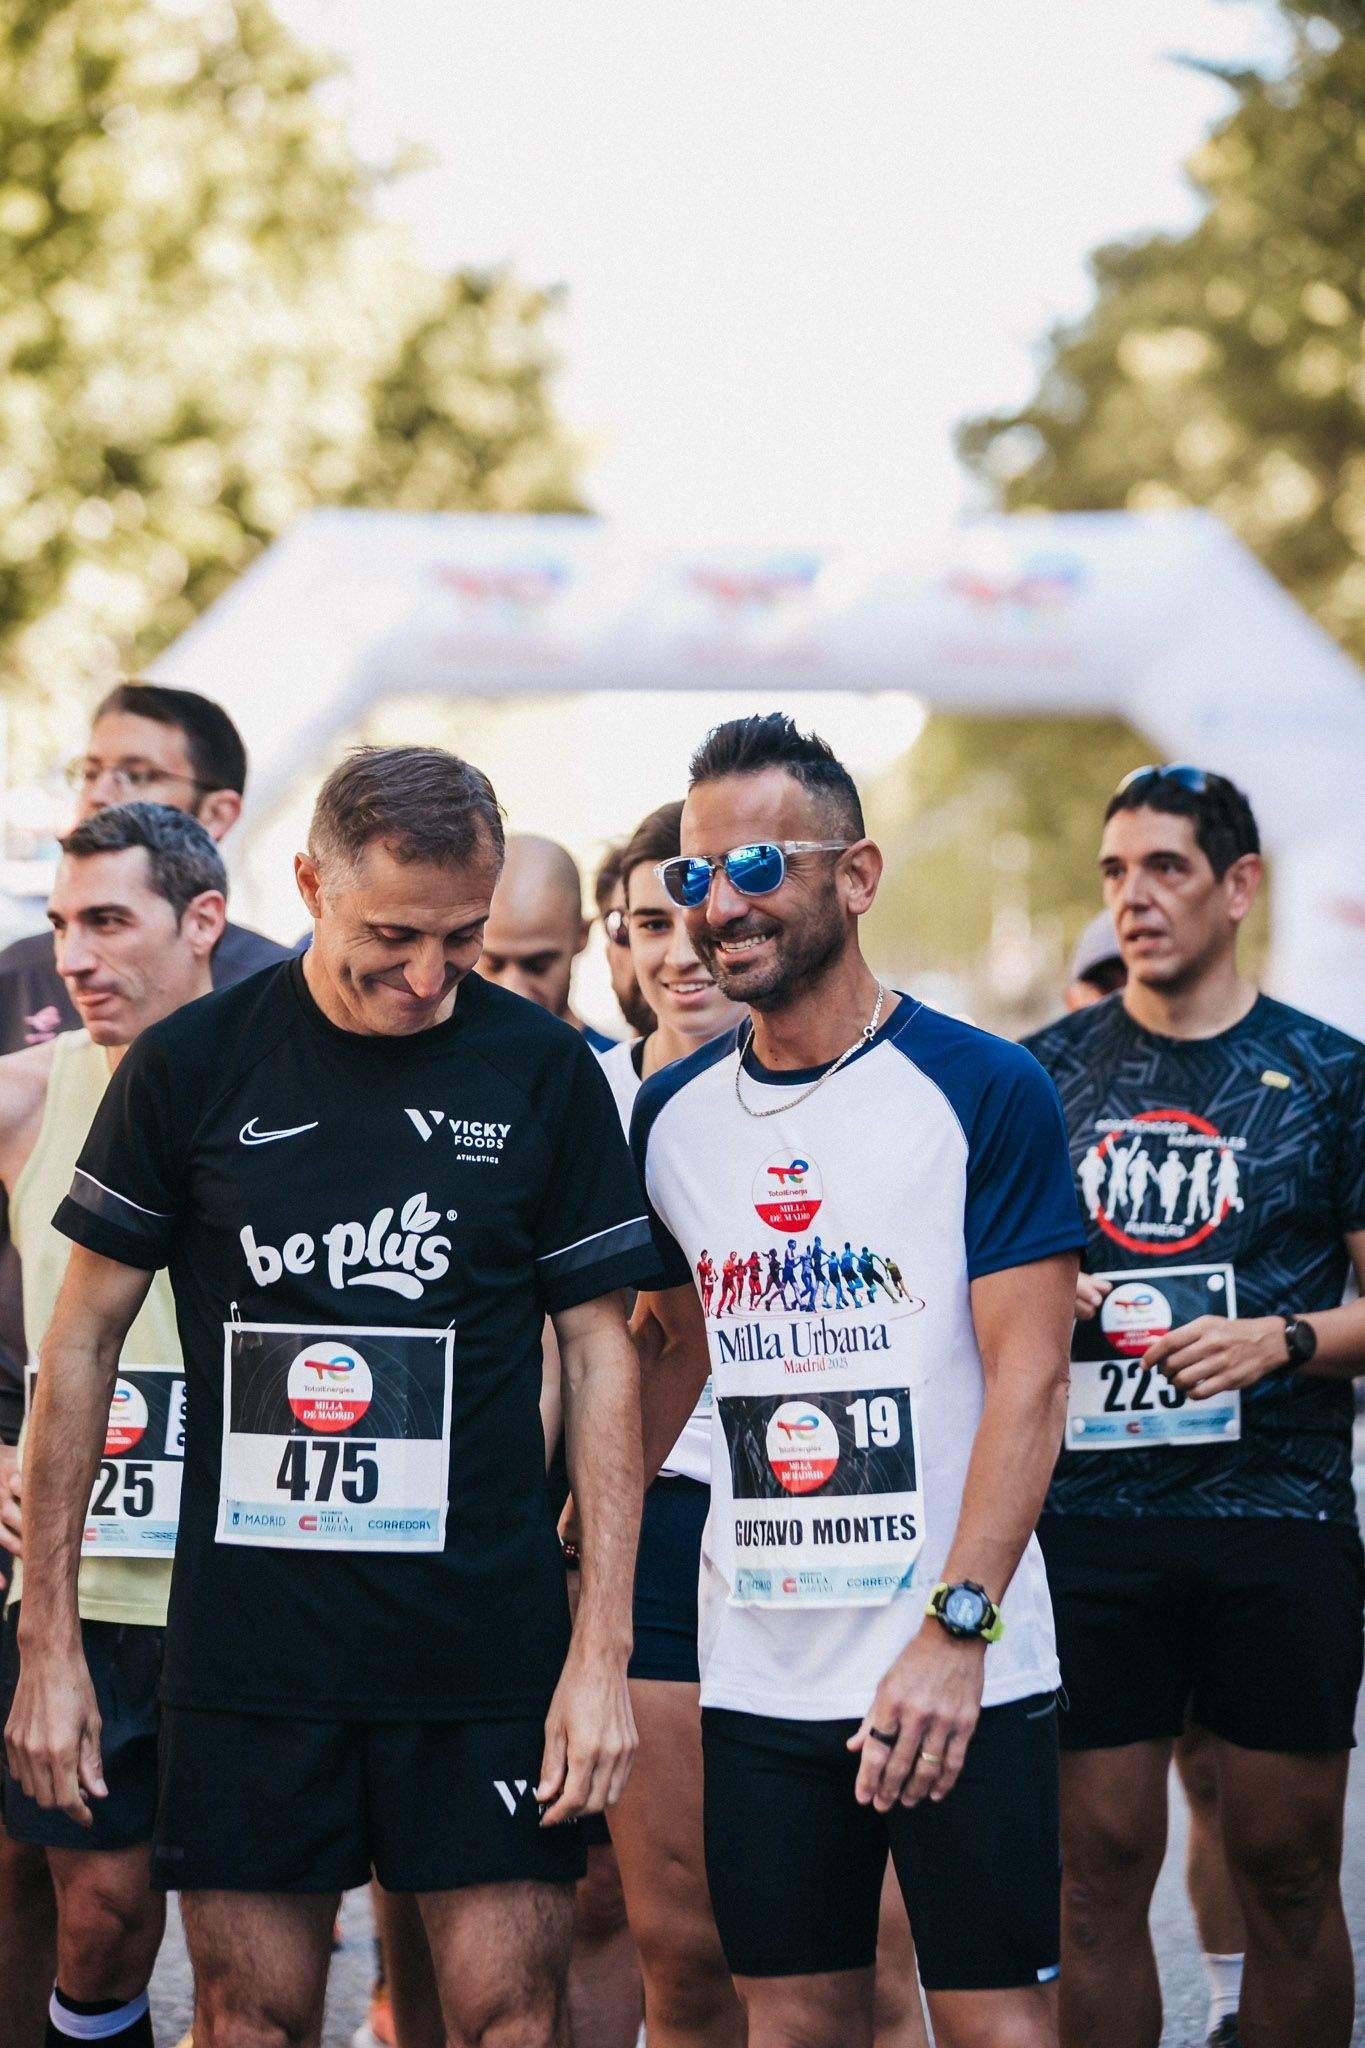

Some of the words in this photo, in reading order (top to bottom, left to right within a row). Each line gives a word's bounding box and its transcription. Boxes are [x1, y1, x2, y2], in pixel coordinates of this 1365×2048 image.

[449, 1119, 511, 1138] VICKY
[454, 1135, 504, 1149] FOODS
[456, 1154, 499, 1164] ATHLETICS
[770, 1214, 782, 1223] DE
[239, 1224, 316, 1287] be
[322, 1207, 452, 1289] plus
[714, 1322, 785, 1364] Milla
[789, 1317, 892, 1358] Urbana
[783, 1356, 826, 1374] Madrid
[303, 1384, 355, 1394] TotalEnergies
[314, 1401, 344, 1410] MILLA
[303, 1410, 317, 1420] DE
[319, 1410, 355, 1421] MADRID
[845, 1396, 901, 1449] 19
[276, 1440, 379, 1504] 475
[244, 1513, 286, 1526] MADRID
[735, 1518, 803, 1547] GUSTAVO
[813, 1514, 917, 1545] MONTES
